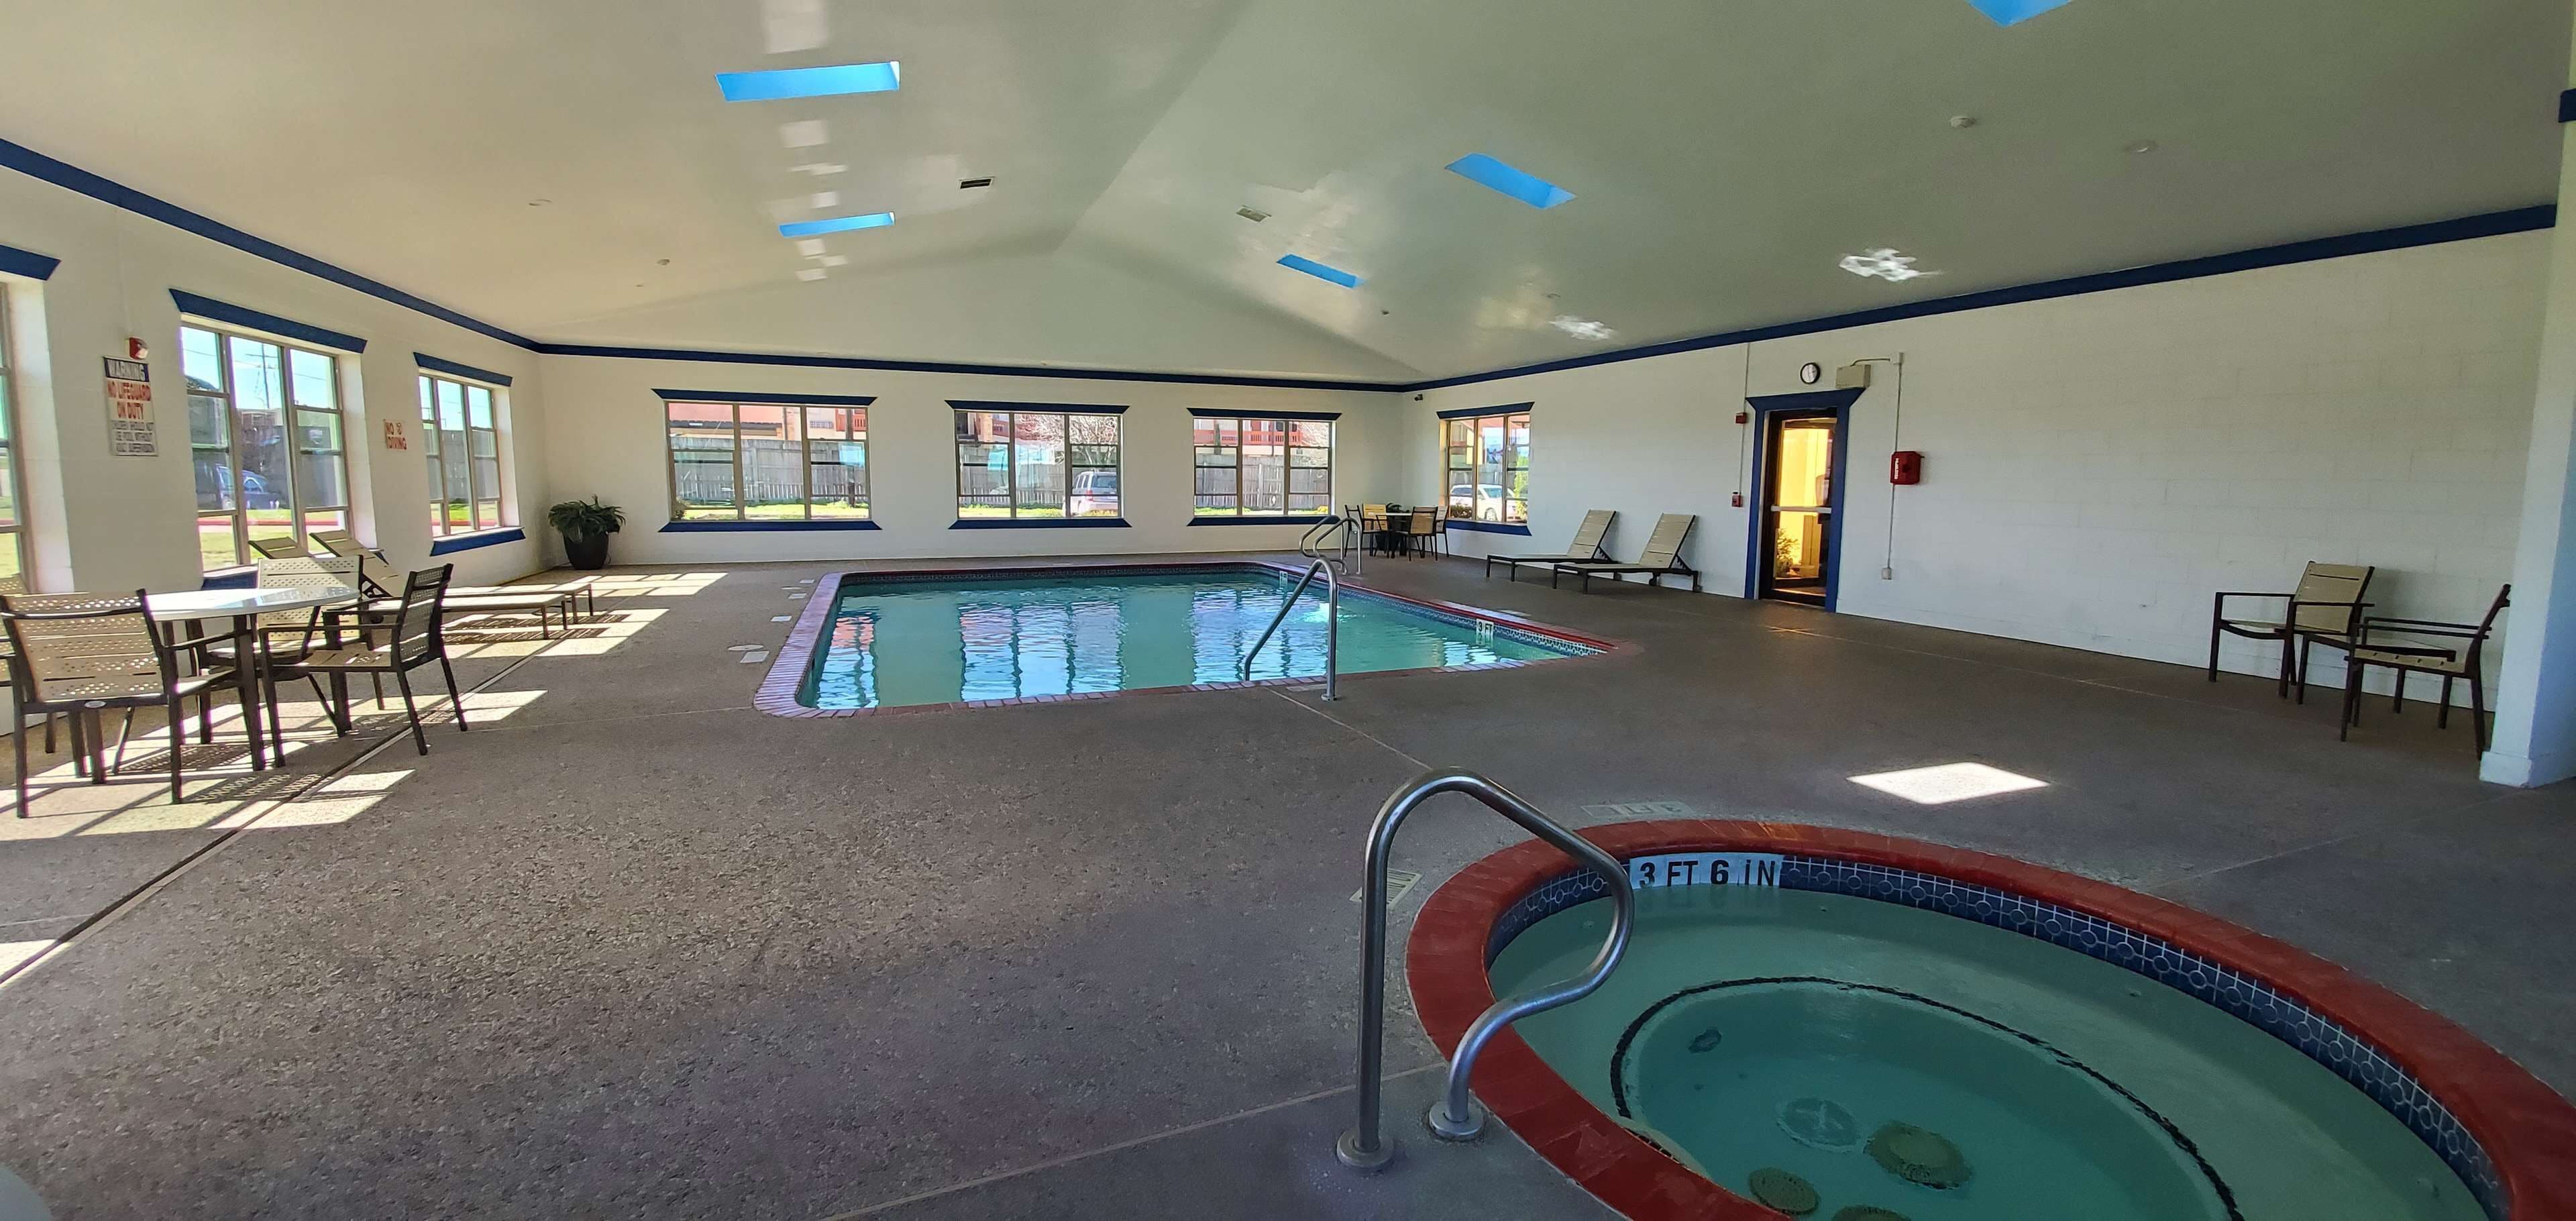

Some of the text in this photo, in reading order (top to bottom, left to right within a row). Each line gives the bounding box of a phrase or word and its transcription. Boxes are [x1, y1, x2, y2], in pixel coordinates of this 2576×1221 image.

[107, 359, 146, 381] WARNING
[107, 380, 151, 401] NO LIFEGUARD
[117, 402, 144, 419] ON DUTY
[386, 422, 394, 435] NO
[386, 436, 407, 449] DIVING
[1478, 621, 1493, 634] 3 FT
[1640, 861, 1655, 888] 3
[1667, 860, 1699, 887] FT
[1711, 859, 1729, 885] 6
